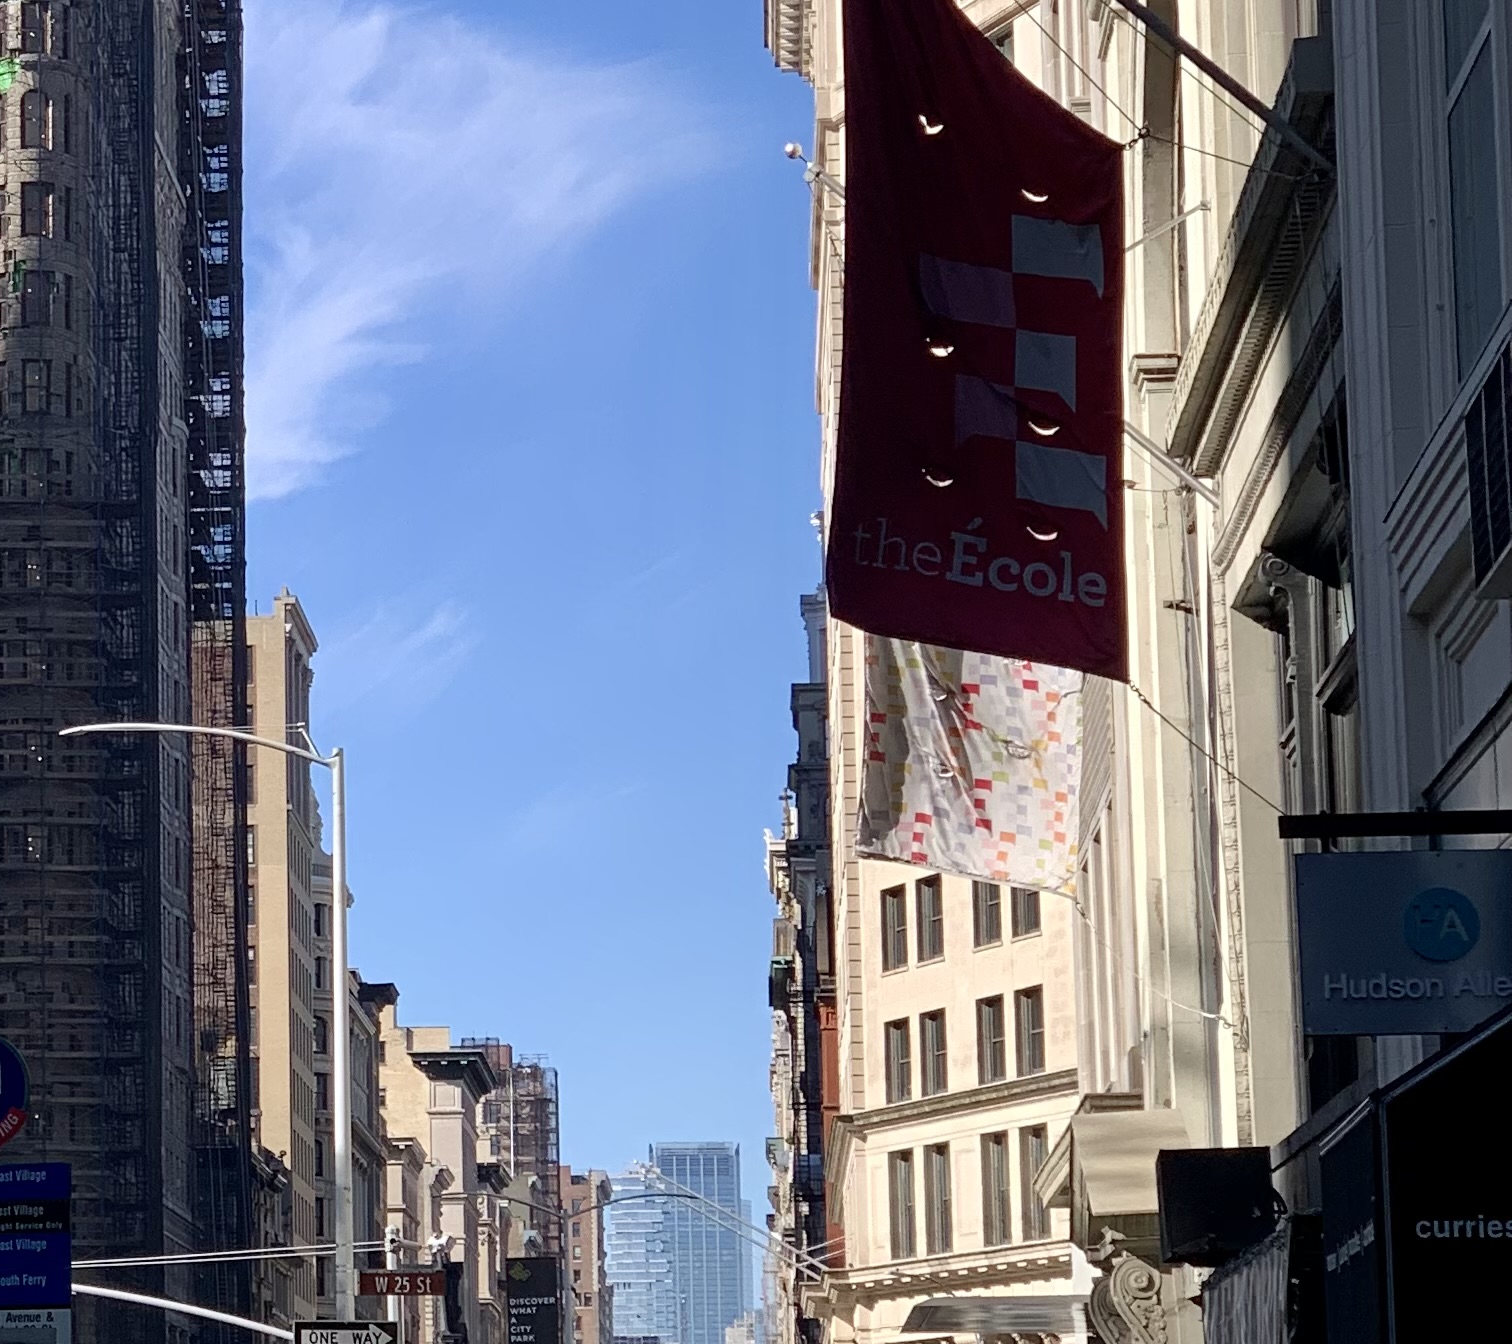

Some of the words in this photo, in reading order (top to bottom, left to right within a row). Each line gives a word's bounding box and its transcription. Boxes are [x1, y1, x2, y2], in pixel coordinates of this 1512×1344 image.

[1324, 972, 1444, 1000] Hudson
[15, 1169, 47, 1183] Village
[13, 1205, 45, 1217] Village
[15, 1222, 44, 1230] Service
[15, 1239, 47, 1252] Village
[23, 1274, 47, 1288] Ferry
[375, 1276, 388, 1293] W
[394, 1276, 410, 1293] 25
[417, 1276, 431, 1293] St
[509, 1296, 556, 1306] DISCOVER
[510, 1307, 537, 1315] WHAT
[5, 1312, 42, 1323] Avenue
[46, 1312, 54, 1323] &
[309, 1331, 338, 1344] ONE
[352, 1331, 383, 1344] WAY
[510, 1335, 536, 1343] PARK
